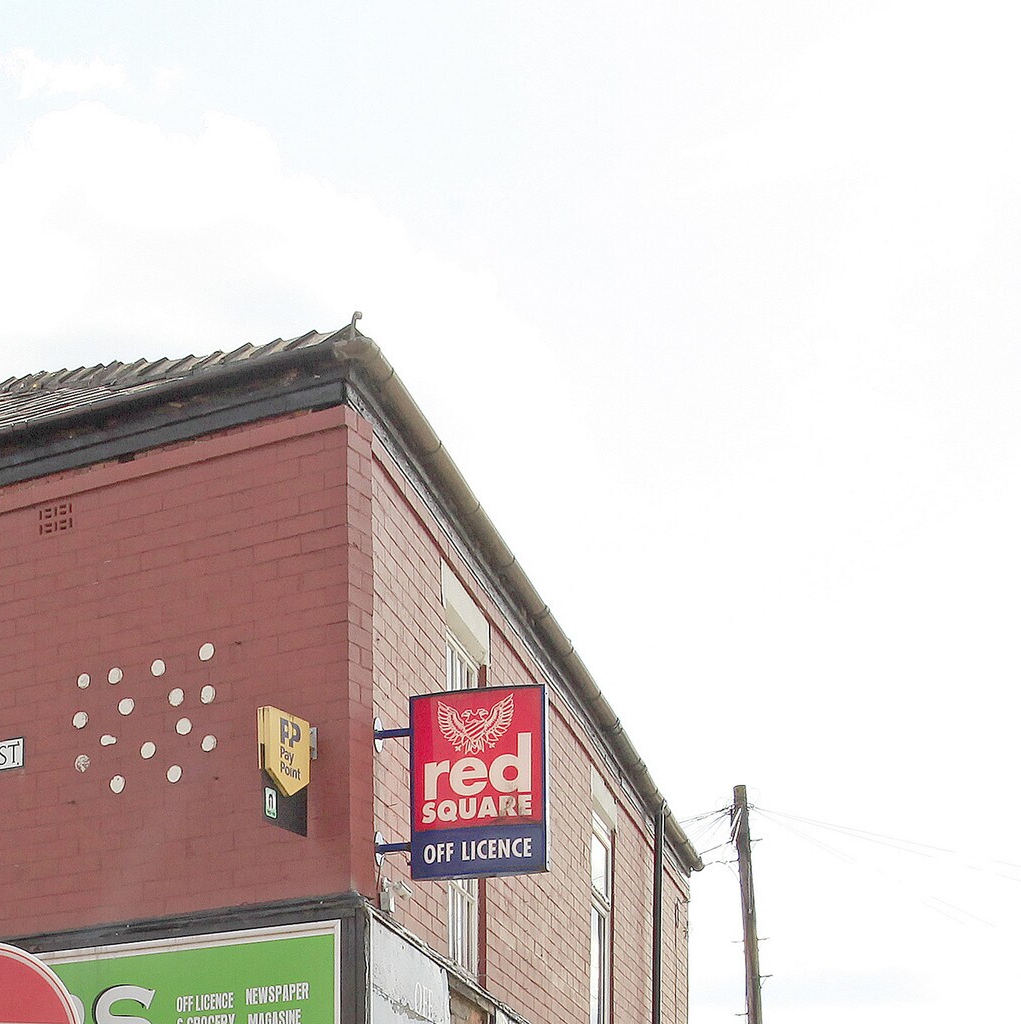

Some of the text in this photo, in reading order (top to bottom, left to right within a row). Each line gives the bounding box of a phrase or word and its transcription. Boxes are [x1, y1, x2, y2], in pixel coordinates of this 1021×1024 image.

[280, 747, 294, 765] Pay
[424, 732, 532, 800] red
[280, 761, 301, 780] Point
[422, 794, 532, 824] SQUARE
[424, 838, 532, 864] OFF LICENCE
[177, 992, 234, 1013] OFF LICENCE
[245, 982, 310, 1006] NEWSPAPER
